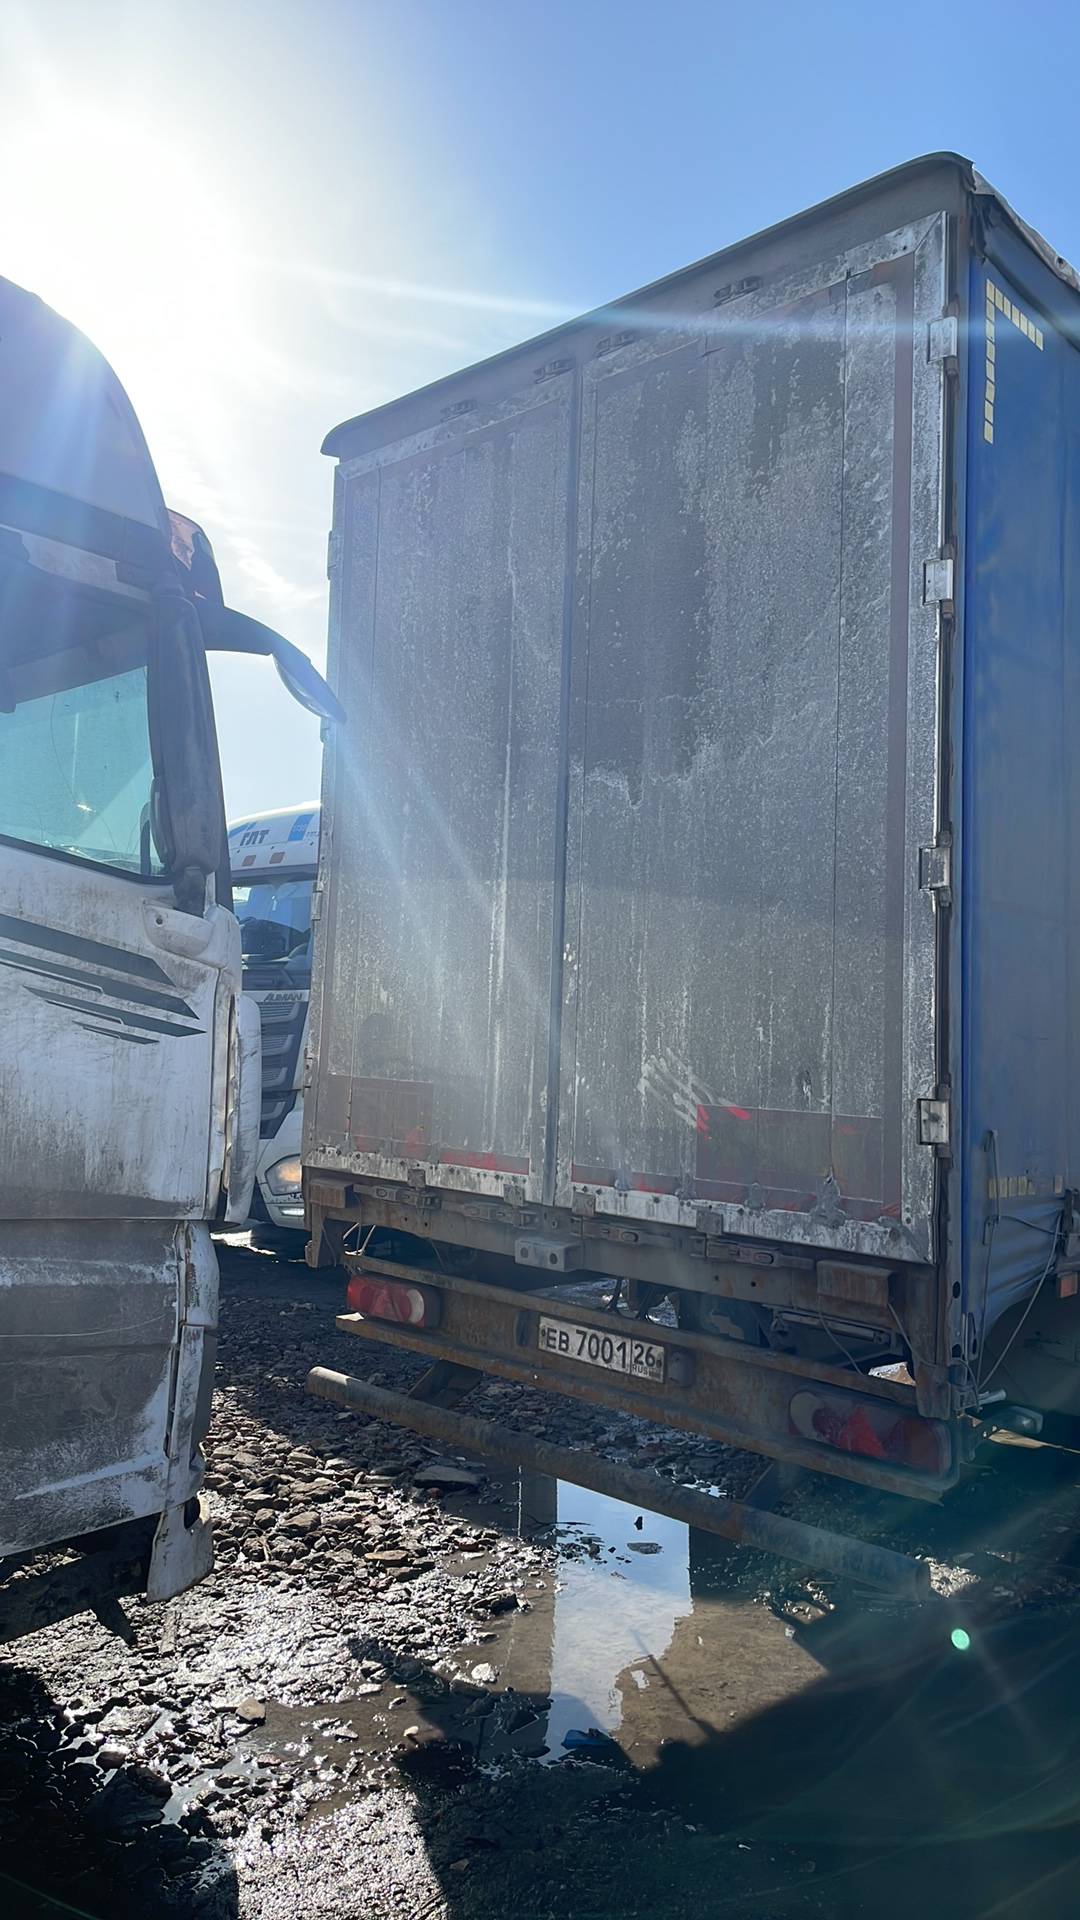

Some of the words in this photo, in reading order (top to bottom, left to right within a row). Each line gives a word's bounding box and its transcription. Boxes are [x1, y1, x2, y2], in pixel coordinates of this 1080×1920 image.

[264, 992, 303, 1002] AUMAN
[575, 1329, 627, 1369] 7001
[634, 1343, 656, 1367] 26
[632, 1364, 648, 1376] RUS
